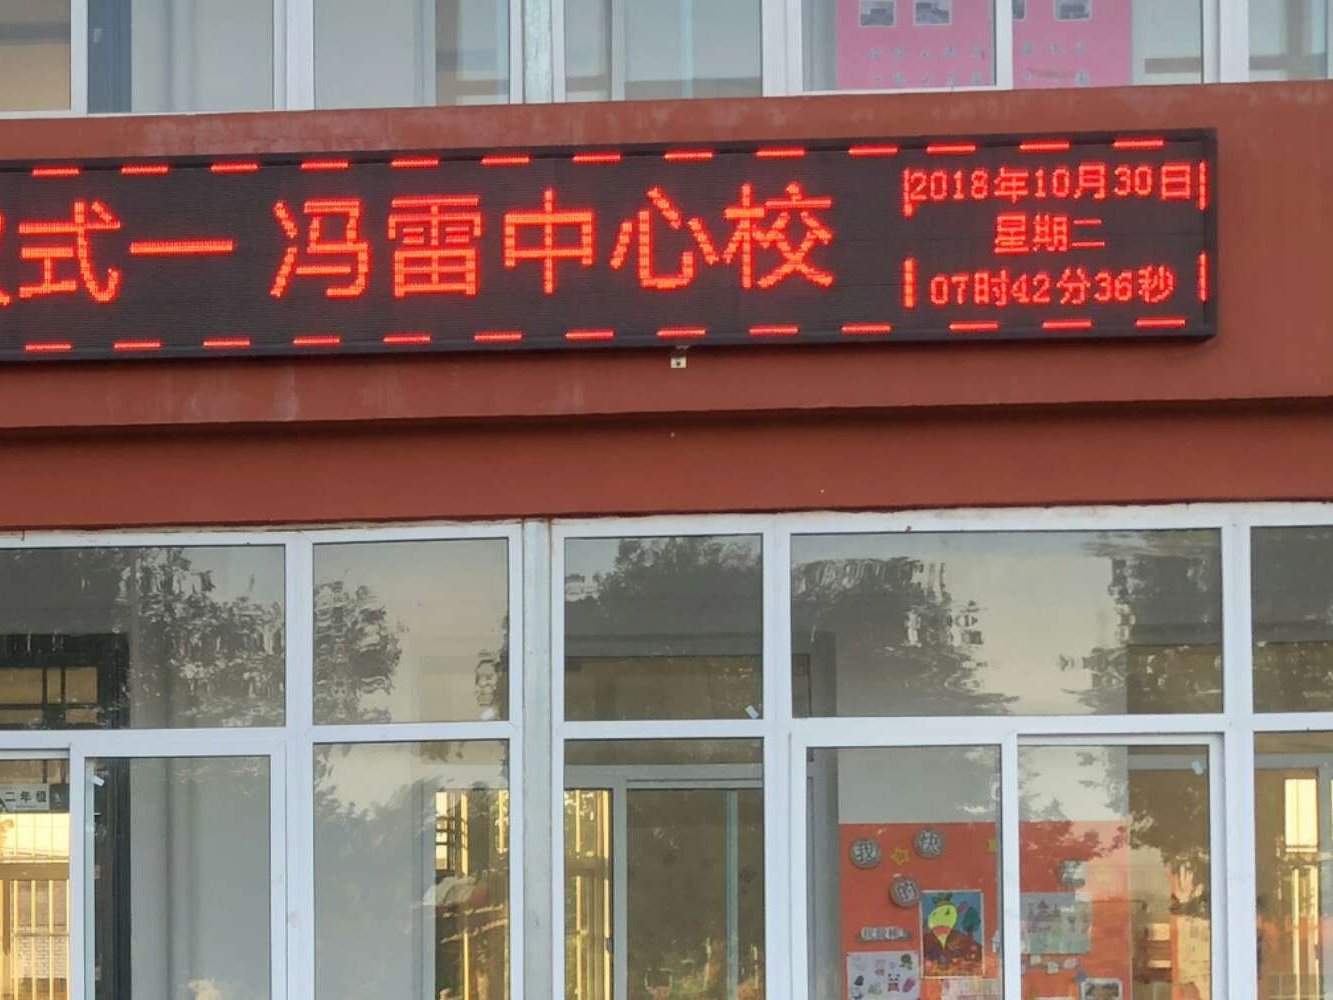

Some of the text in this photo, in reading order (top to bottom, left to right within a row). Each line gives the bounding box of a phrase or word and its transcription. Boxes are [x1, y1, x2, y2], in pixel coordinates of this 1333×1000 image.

[911, 162, 1192, 203] 2018年10月30日
[993, 212, 1106, 254] 星期二
[929, 264, 1176, 306] 07时42分36秒
